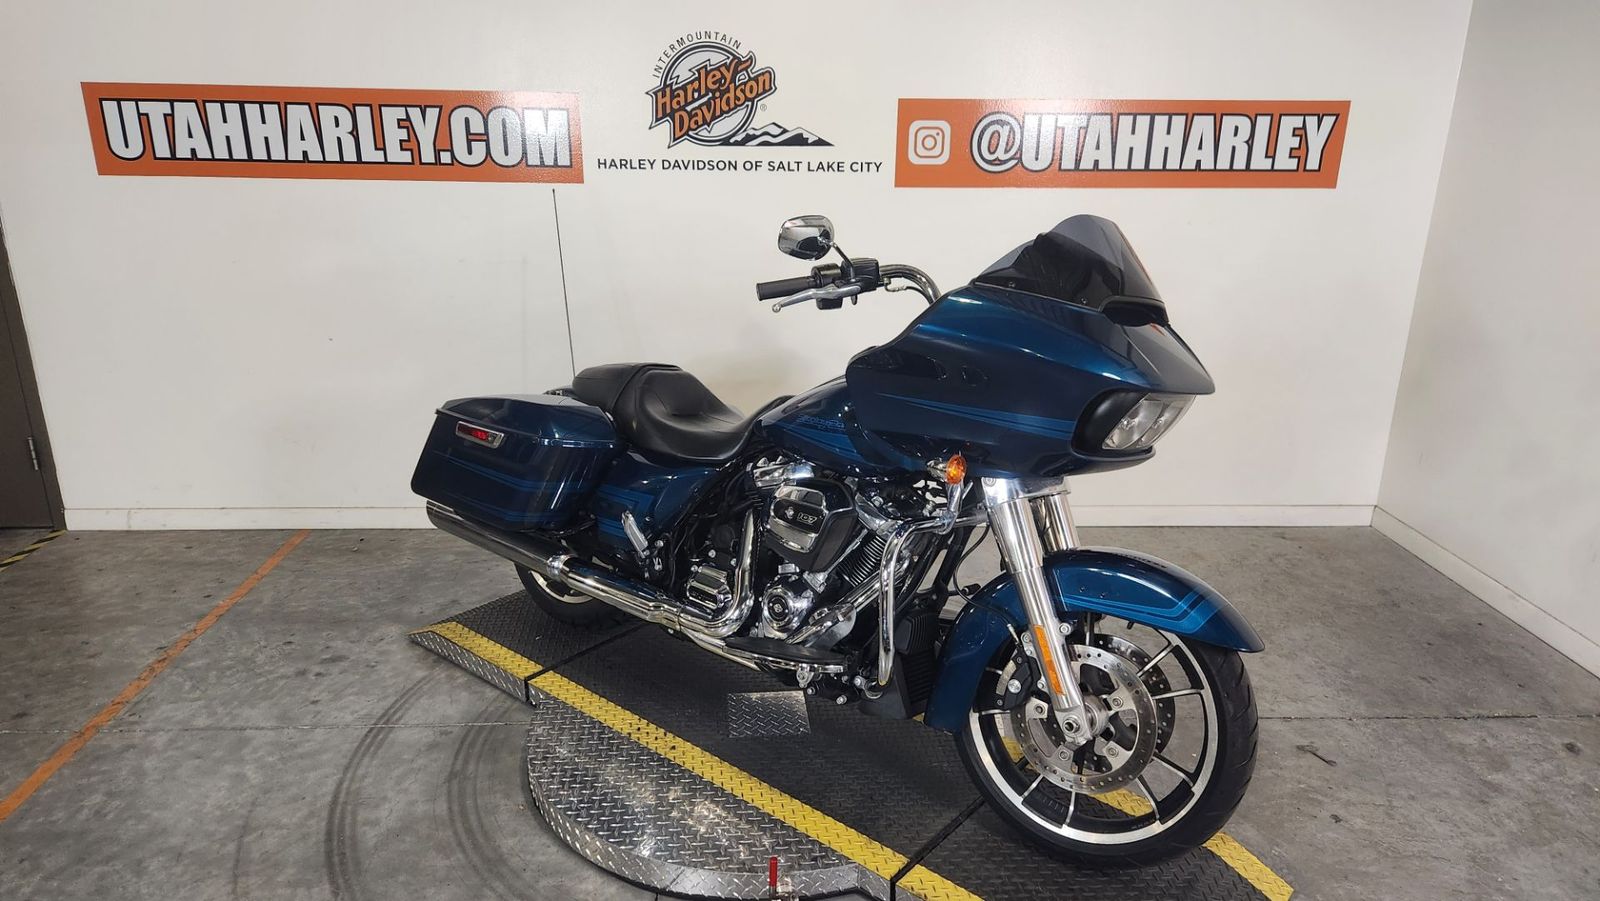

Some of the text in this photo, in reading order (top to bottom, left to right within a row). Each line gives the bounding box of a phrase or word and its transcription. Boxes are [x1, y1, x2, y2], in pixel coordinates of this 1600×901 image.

[652, 30, 742, 79] INTERMOUNTAIN
[99, 98, 573, 168] UTAHHARLEY.COM
[673, 69, 772, 139] Davidson
[597, 158, 883, 173] HARLEY DAVIDSON OF SALT LAKE CITY
[970, 111, 1340, 173] @UTAHHARLEY
